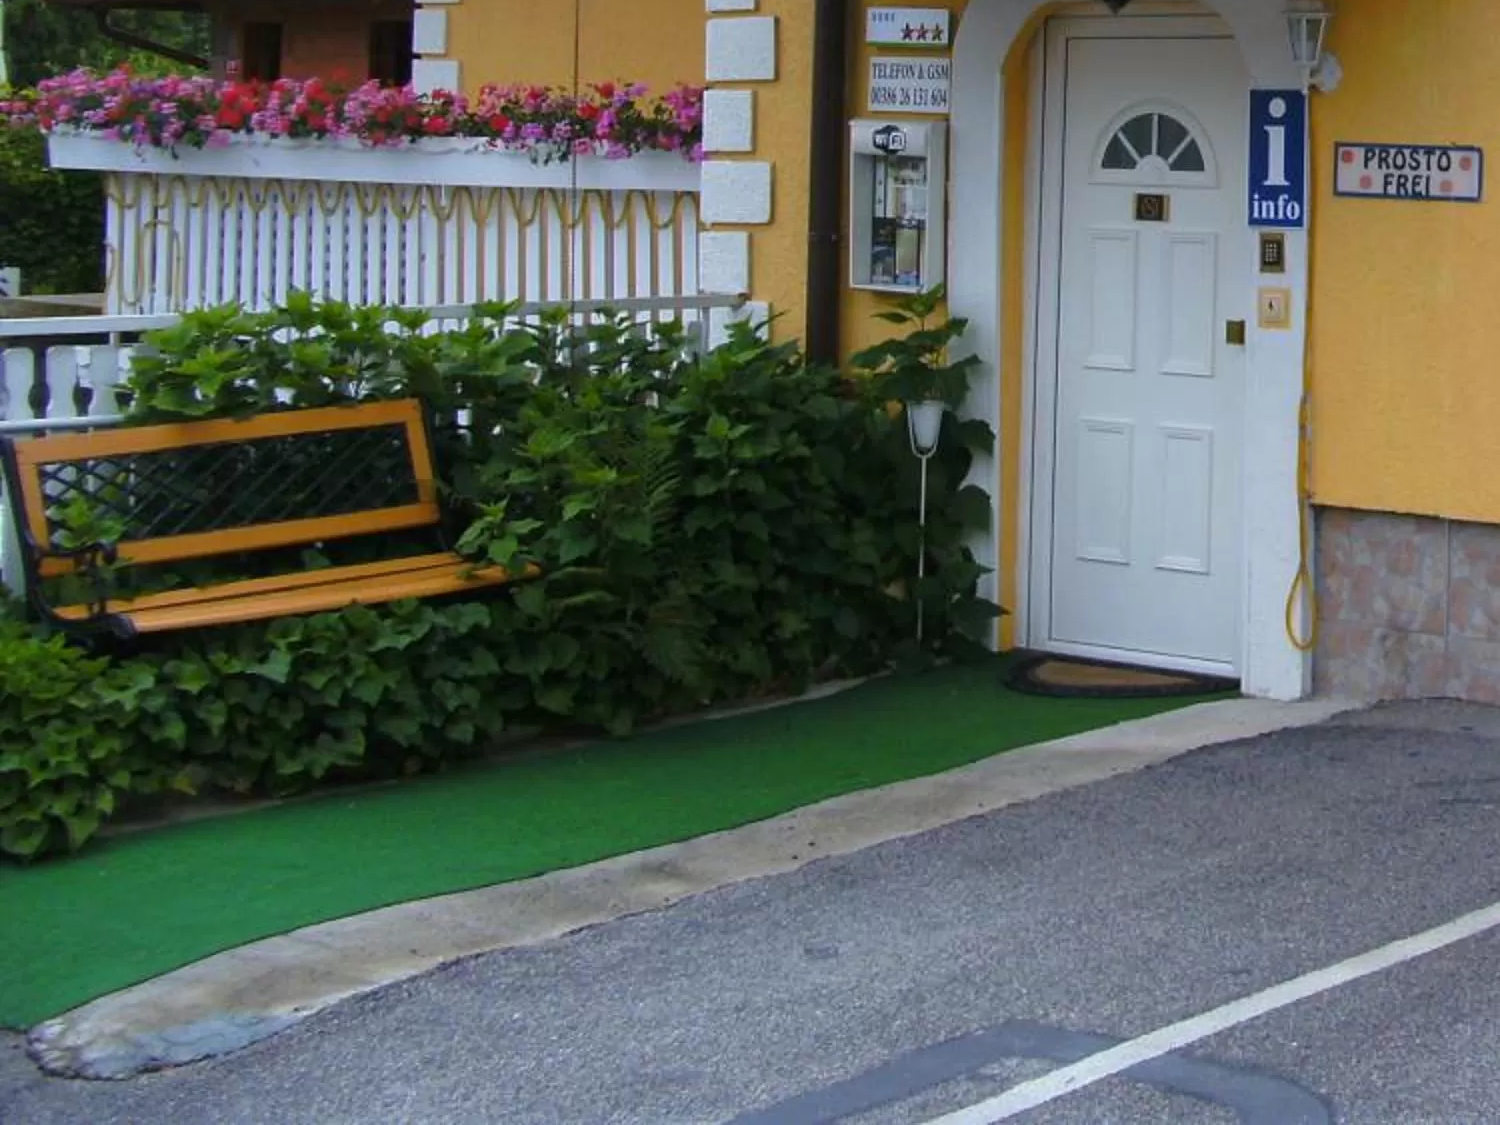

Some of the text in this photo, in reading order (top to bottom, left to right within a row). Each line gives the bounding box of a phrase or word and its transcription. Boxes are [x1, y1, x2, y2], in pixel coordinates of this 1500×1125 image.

[872, 62, 915, 80] TELEFON
[927, 63, 949, 80] GSM
[1363, 148, 1452, 172] PROSTO
[1383, 173, 1431, 198] FREI
[1252, 194, 1301, 220] info
